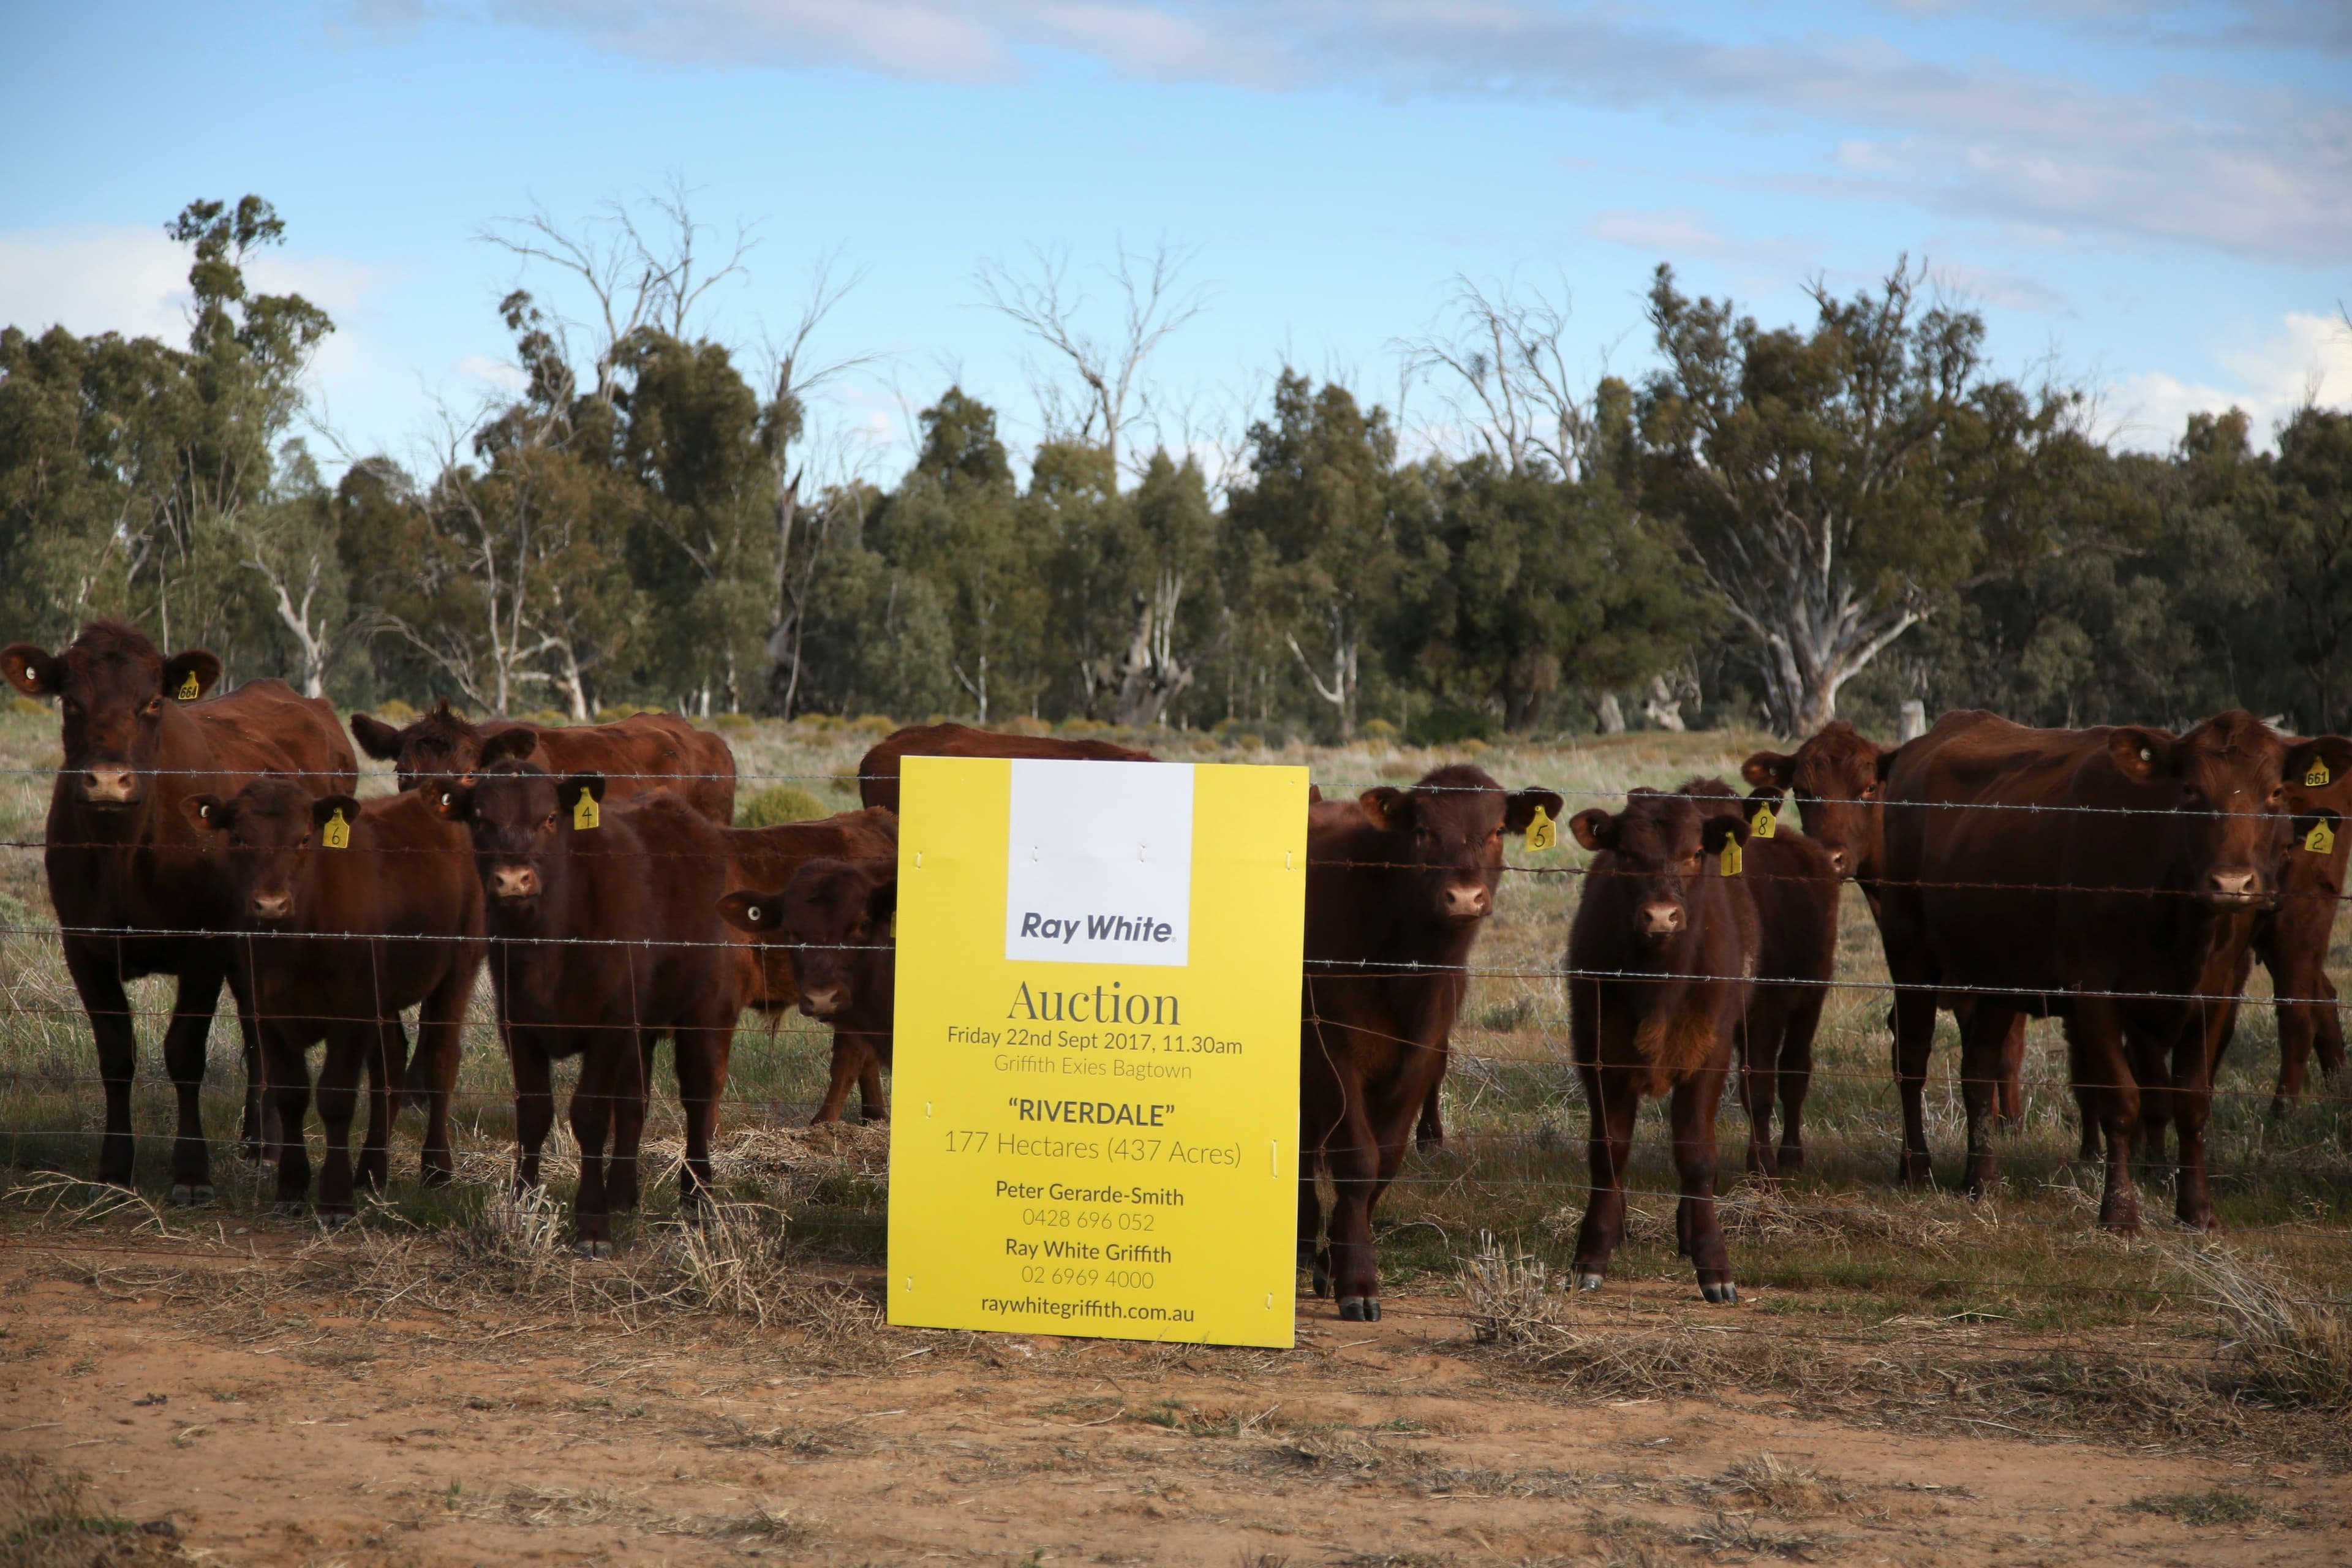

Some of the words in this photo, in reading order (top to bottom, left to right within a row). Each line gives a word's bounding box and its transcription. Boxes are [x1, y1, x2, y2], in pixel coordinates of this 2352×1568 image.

[179, 685, 197, 698] 664
[2307, 772, 2326, 785] 661
[582, 806, 592, 828] 4
[1758, 816, 1768, 835] 8
[331, 826, 340, 845] 6
[1534, 824, 1548, 848] 5
[2313, 832, 2324, 850] 2
[1021, 913, 1081, 944] Ray
[1087, 914, 1172, 943] White
[1006, 981, 1181, 1026] Auction
[948, 1027, 1001, 1049] Friday
[1006, 1029, 1052, 1047] 22nd
[1058, 1031, 1098, 1052] Sept
[1104, 1033, 1156, 1053] 2017,
[1163, 1035, 1242, 1054] 11.30am
[995, 1055, 1055, 1074] Griffith
[1062, 1057, 1107, 1076] Exies
[1114, 1059, 1192, 1081] Bagtown
[945, 1130, 989, 1153] 177
[998, 1133, 1099, 1159] Hectares
[1107, 1137, 1162, 1163] (437
[1169, 1141, 1242, 1168] Acres)
[996, 1181, 1044, 1199] Peter
[1049, 1183, 1183, 1206] Gerarde-Smith
[1022, 1208, 1070, 1227] 0428
[1077, 1211, 1112, 1229] 696
[1118, 1213, 1154, 1232] 052
[1006, 1238, 1039, 1259] Ray
[1044, 1241, 1100, 1259] White
[1106, 1243, 1171, 1263] Griffith
[1022, 1266, 1045, 1284] 02
[1052, 1268, 1099, 1286] 6969
[1105, 1270, 1154, 1289] 4000
[982, 1296, 1194, 1322] raywhitegriffith.com.au
